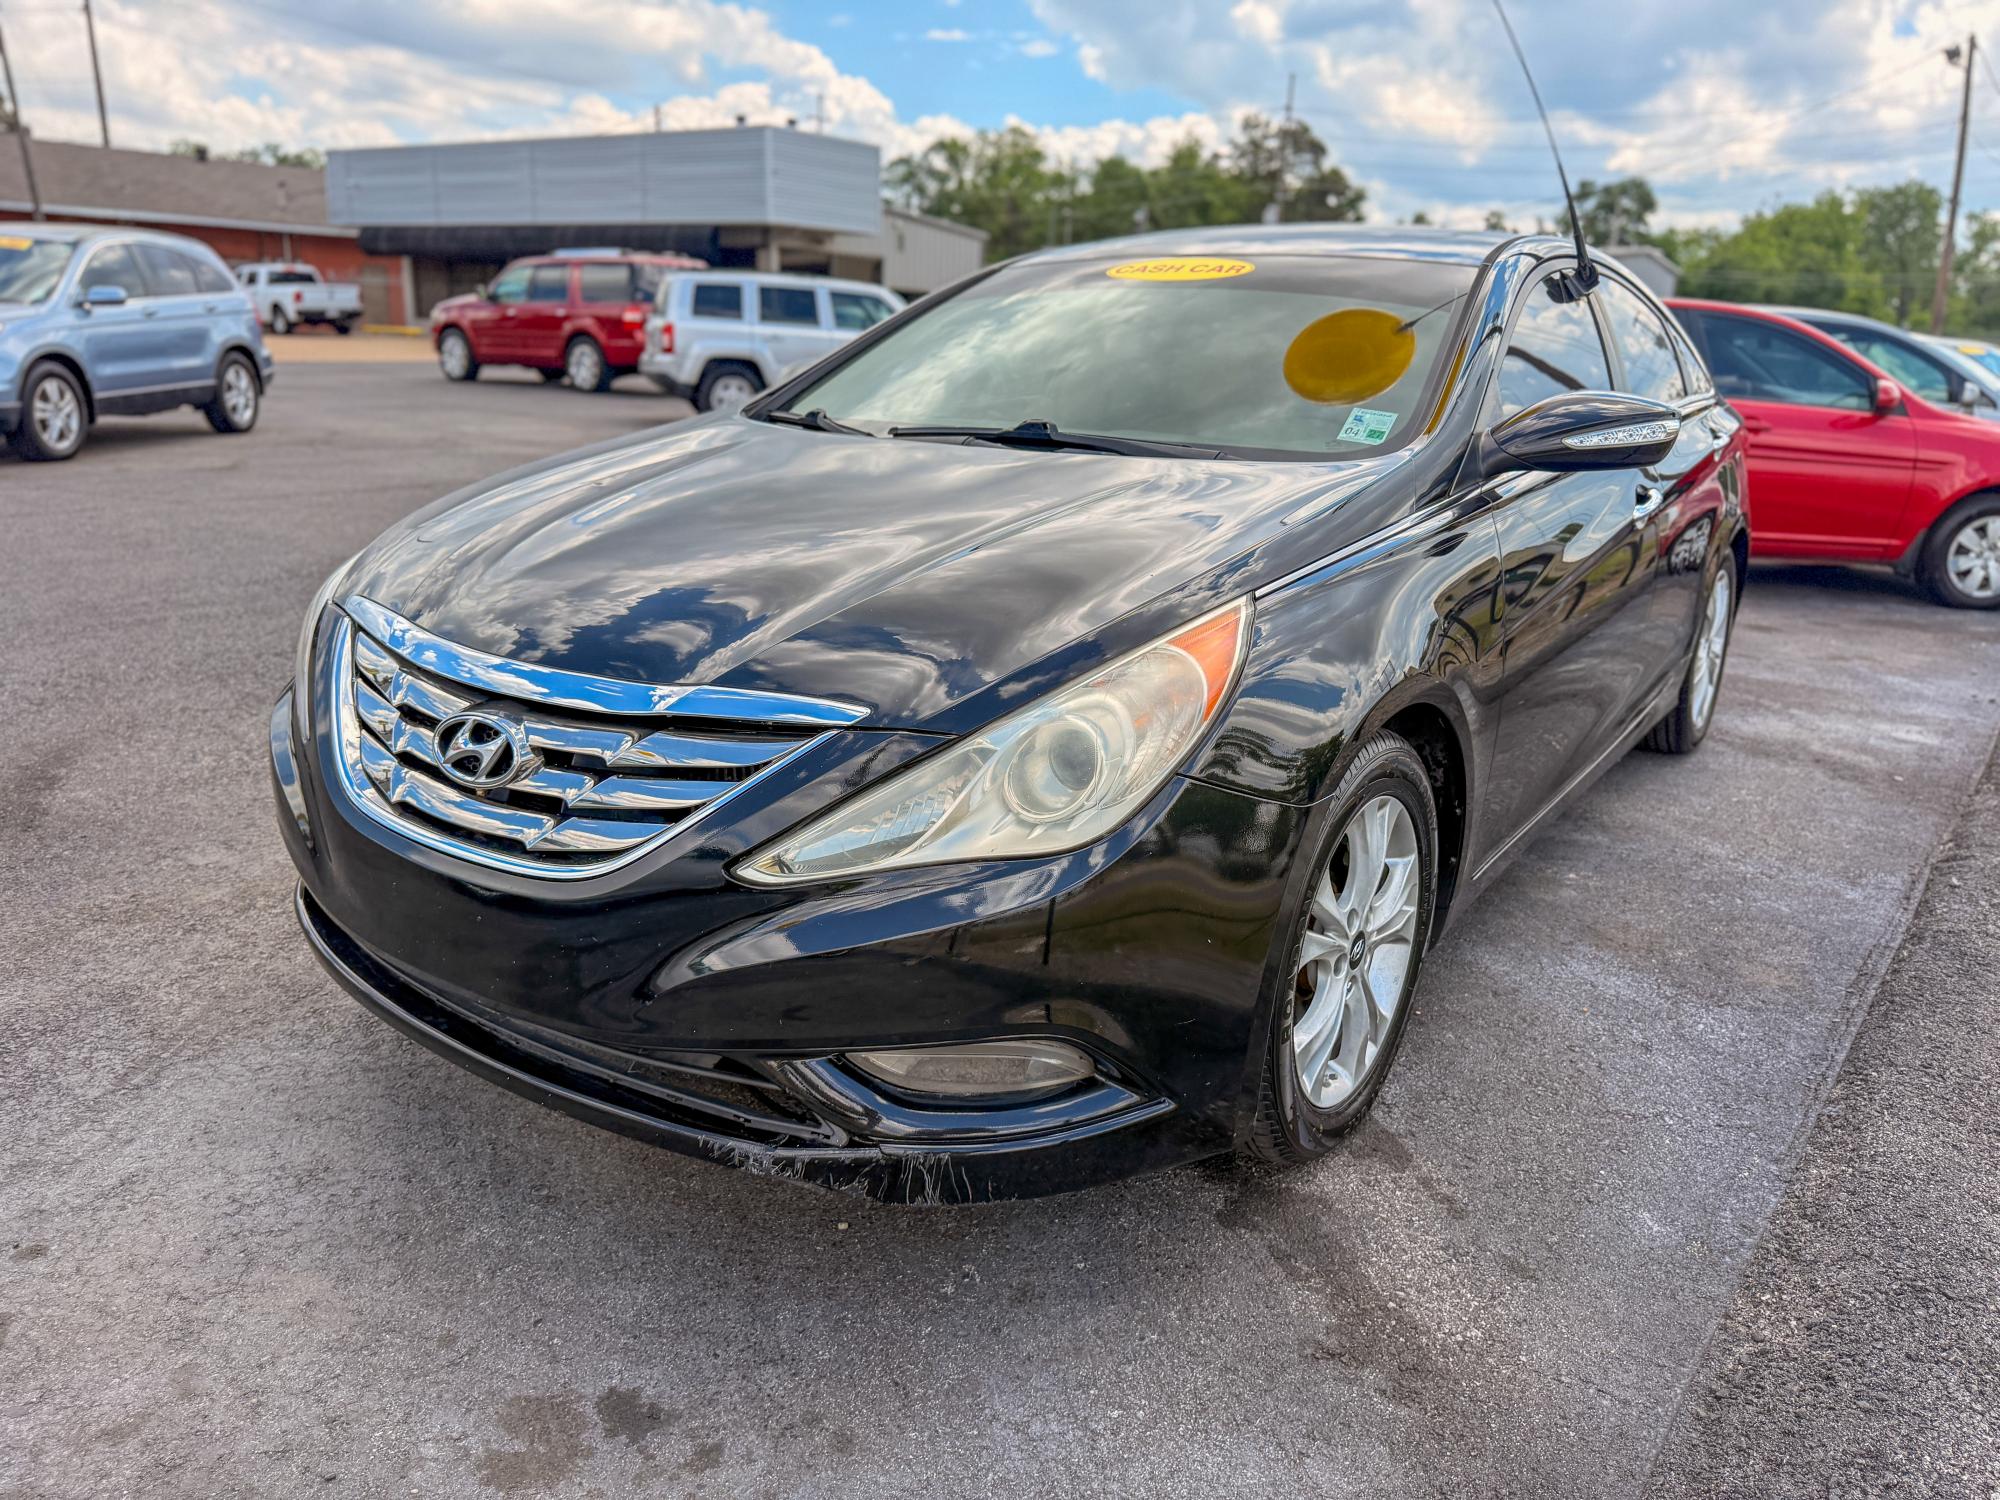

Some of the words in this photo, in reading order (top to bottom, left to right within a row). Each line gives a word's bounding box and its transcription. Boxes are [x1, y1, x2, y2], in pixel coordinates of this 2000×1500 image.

[1115, 264, 1186, 274] CASH
[1190, 264, 1247, 274] CAR
[1344, 427, 1360, 437] 04
